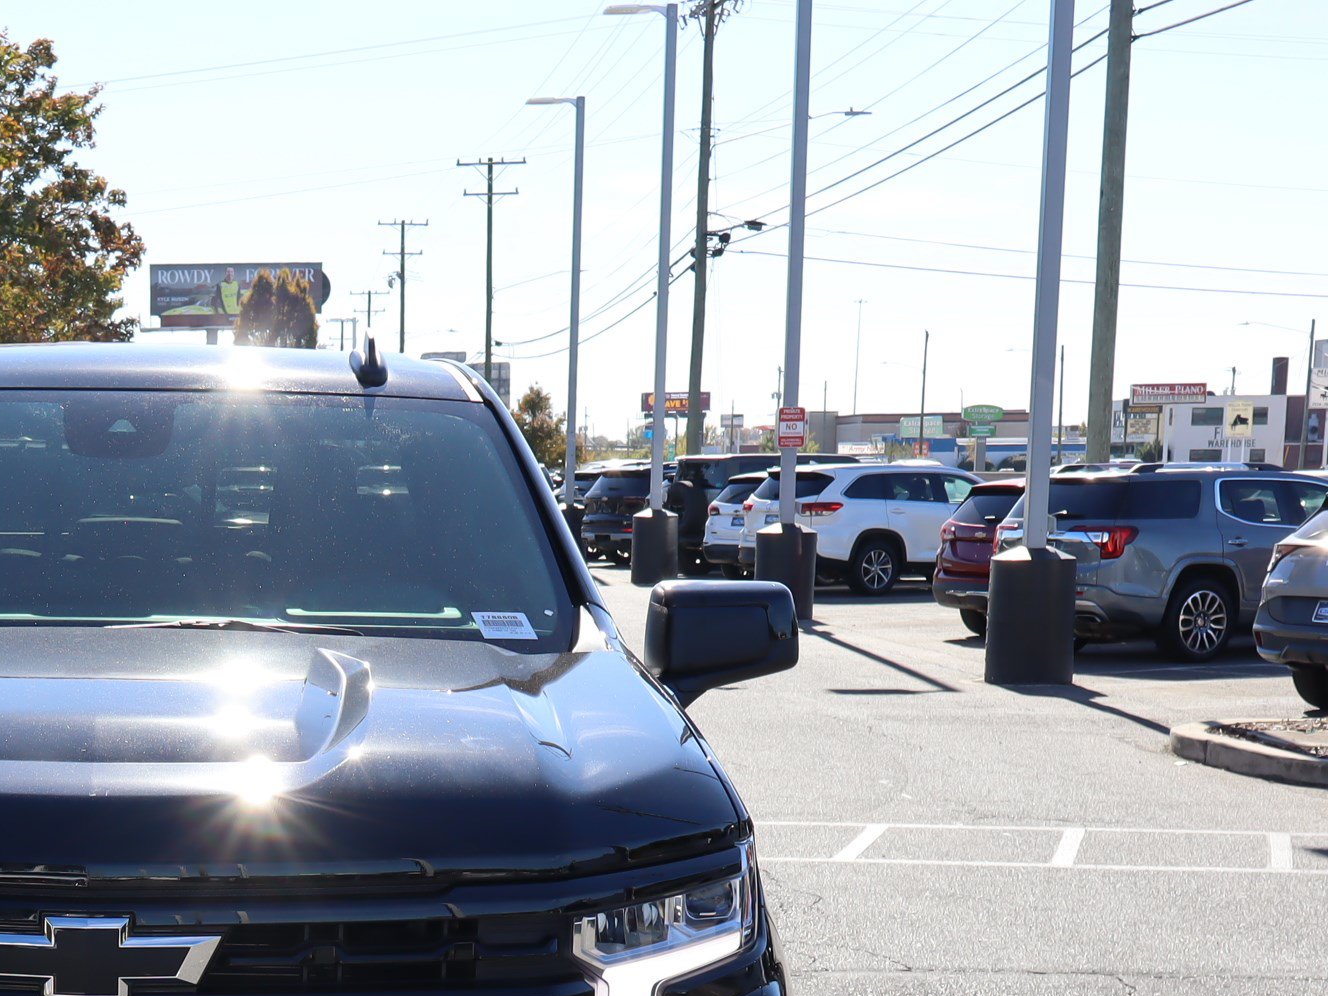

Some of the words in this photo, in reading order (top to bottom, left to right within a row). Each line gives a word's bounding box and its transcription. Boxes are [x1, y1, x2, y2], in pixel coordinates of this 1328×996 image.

[157, 269, 214, 284] ROWDY
[1136, 385, 1170, 395] MILLER
[1174, 385, 1204, 394] PIANO
[785, 423, 798, 431] NO
